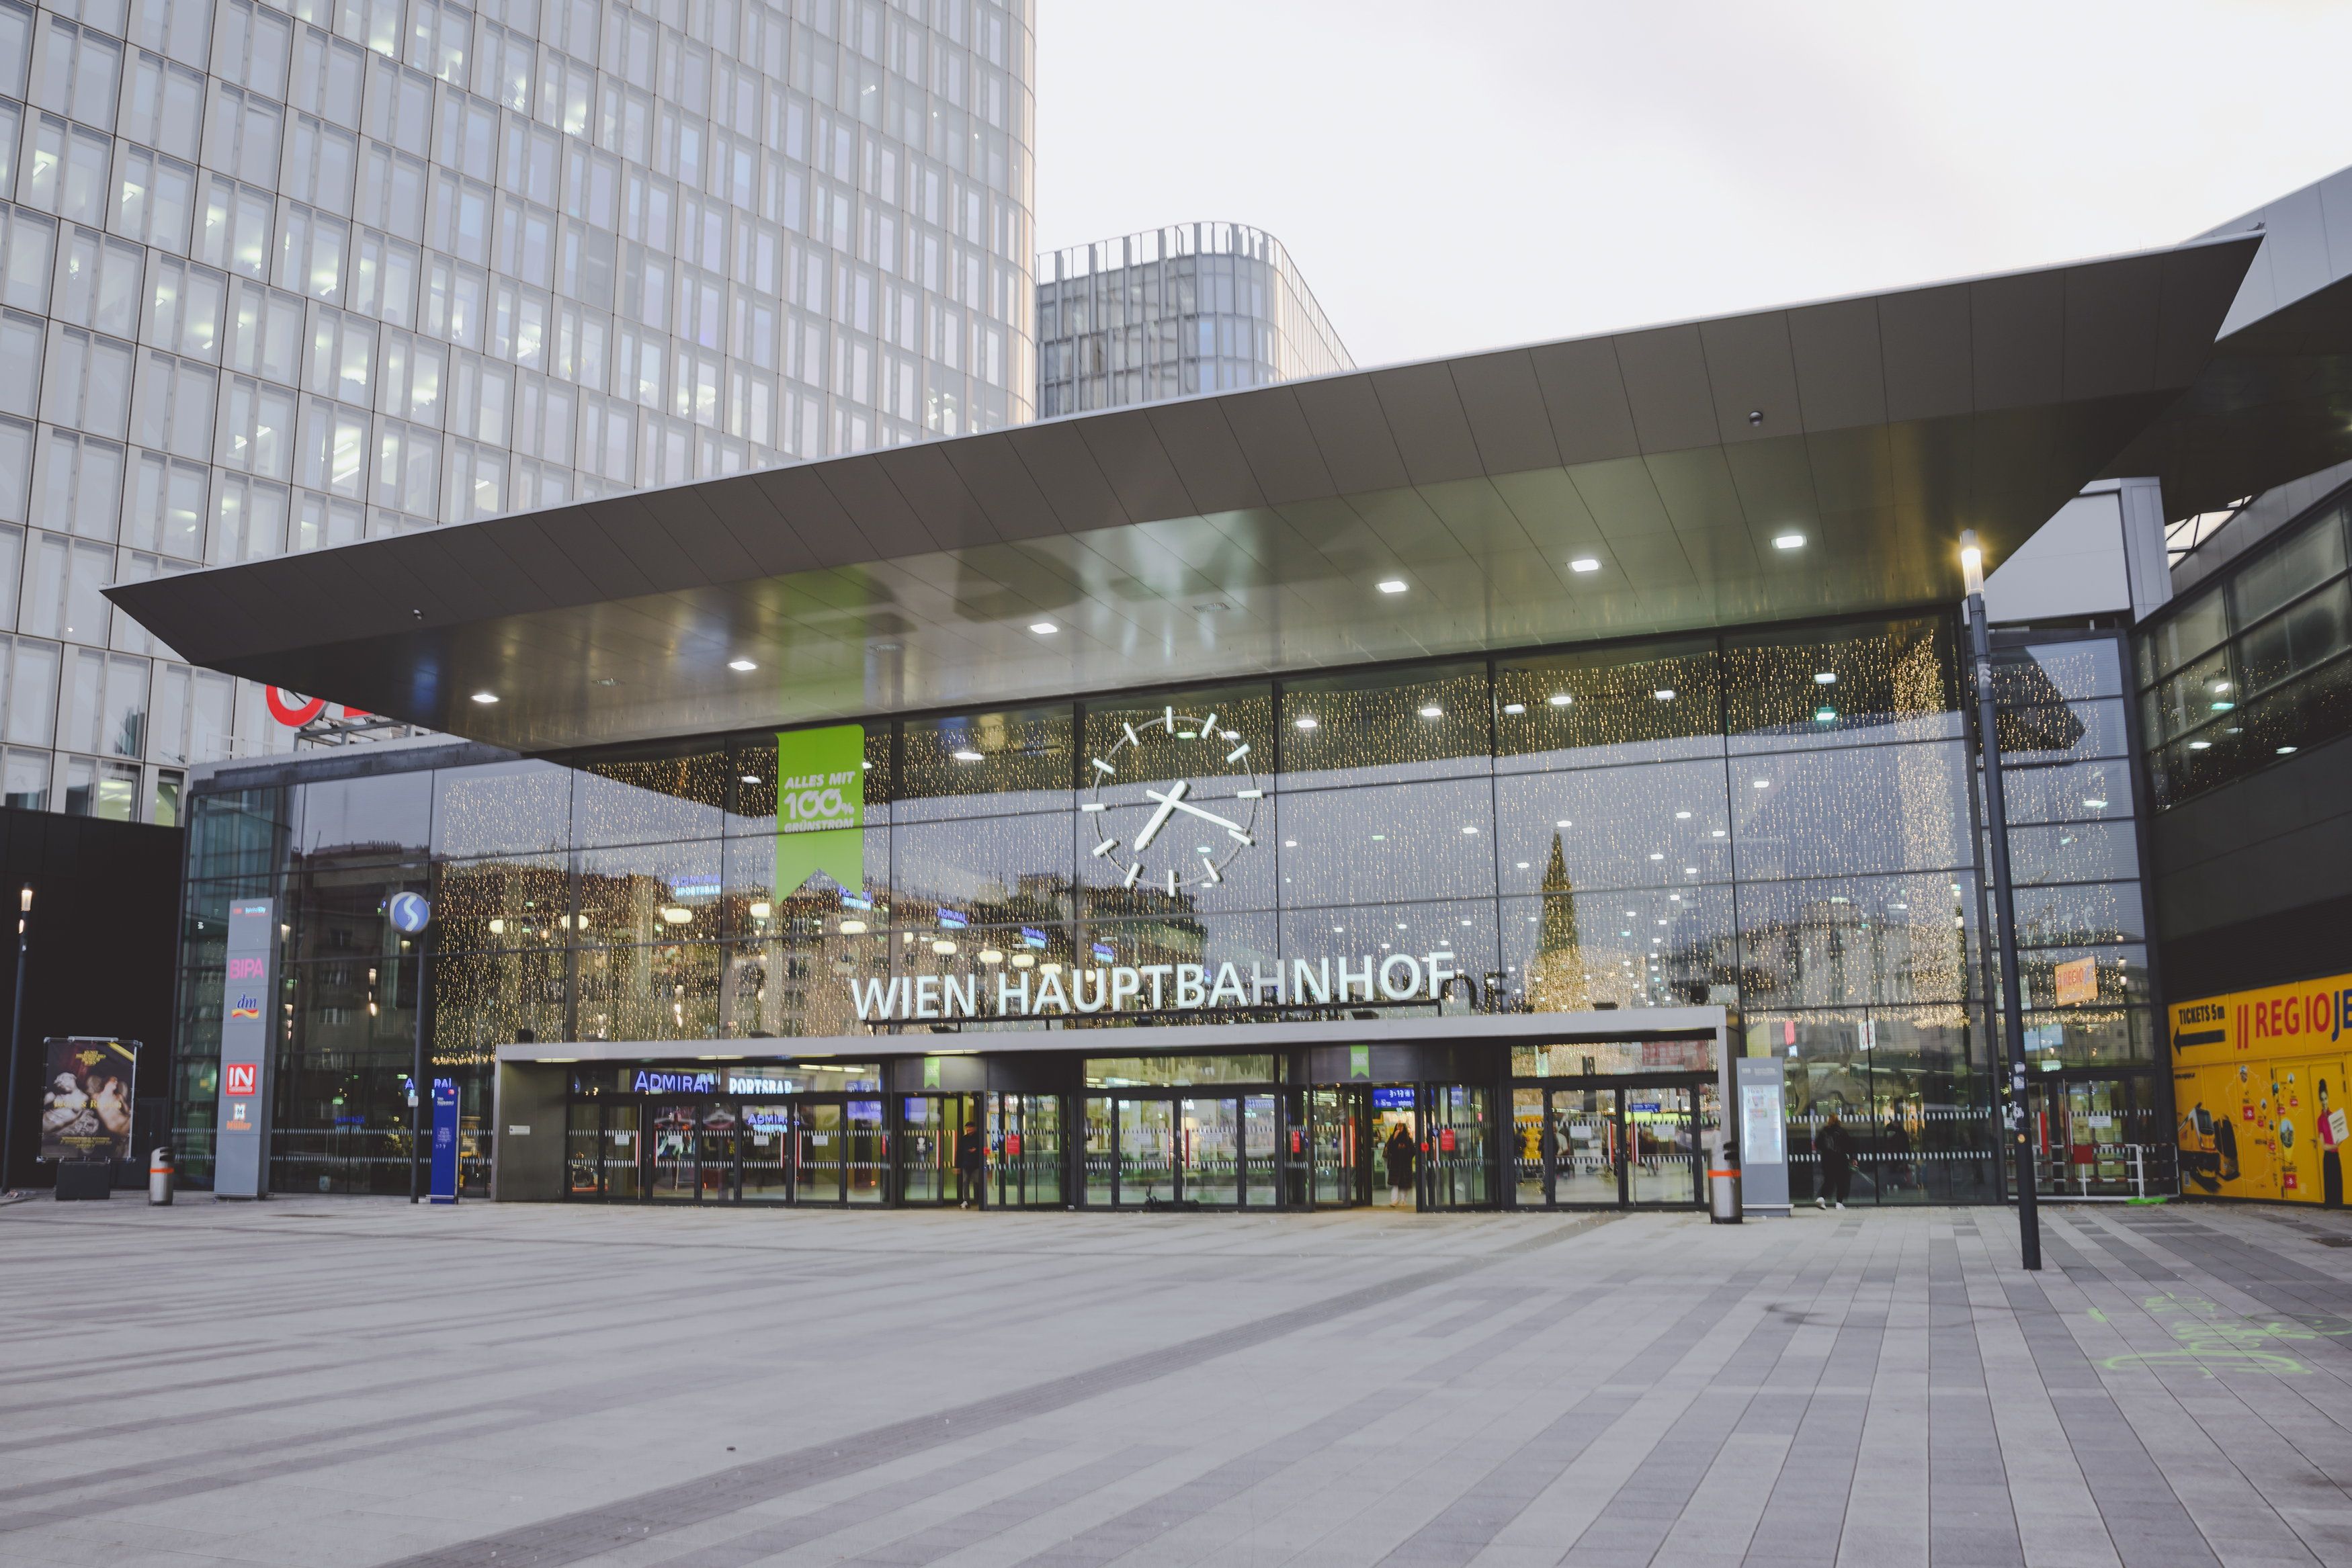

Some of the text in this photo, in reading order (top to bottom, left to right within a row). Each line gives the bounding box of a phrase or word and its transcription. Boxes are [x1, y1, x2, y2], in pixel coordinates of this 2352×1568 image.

[784, 771, 855, 789] ALLES MIT
[784, 788, 854, 820] 100%
[784, 818, 854, 833] GRÜNSTROM
[670, 874, 722, 888] ADMIRA
[230, 957, 264, 979] BIPA
[851, 951, 1454, 1020] WIEN HAUPTBAHNHOF
[237, 994, 257, 1008] dm
[2179, 1004, 2210, 1025] TICKETS
[229, 1067, 253, 1086] IN
